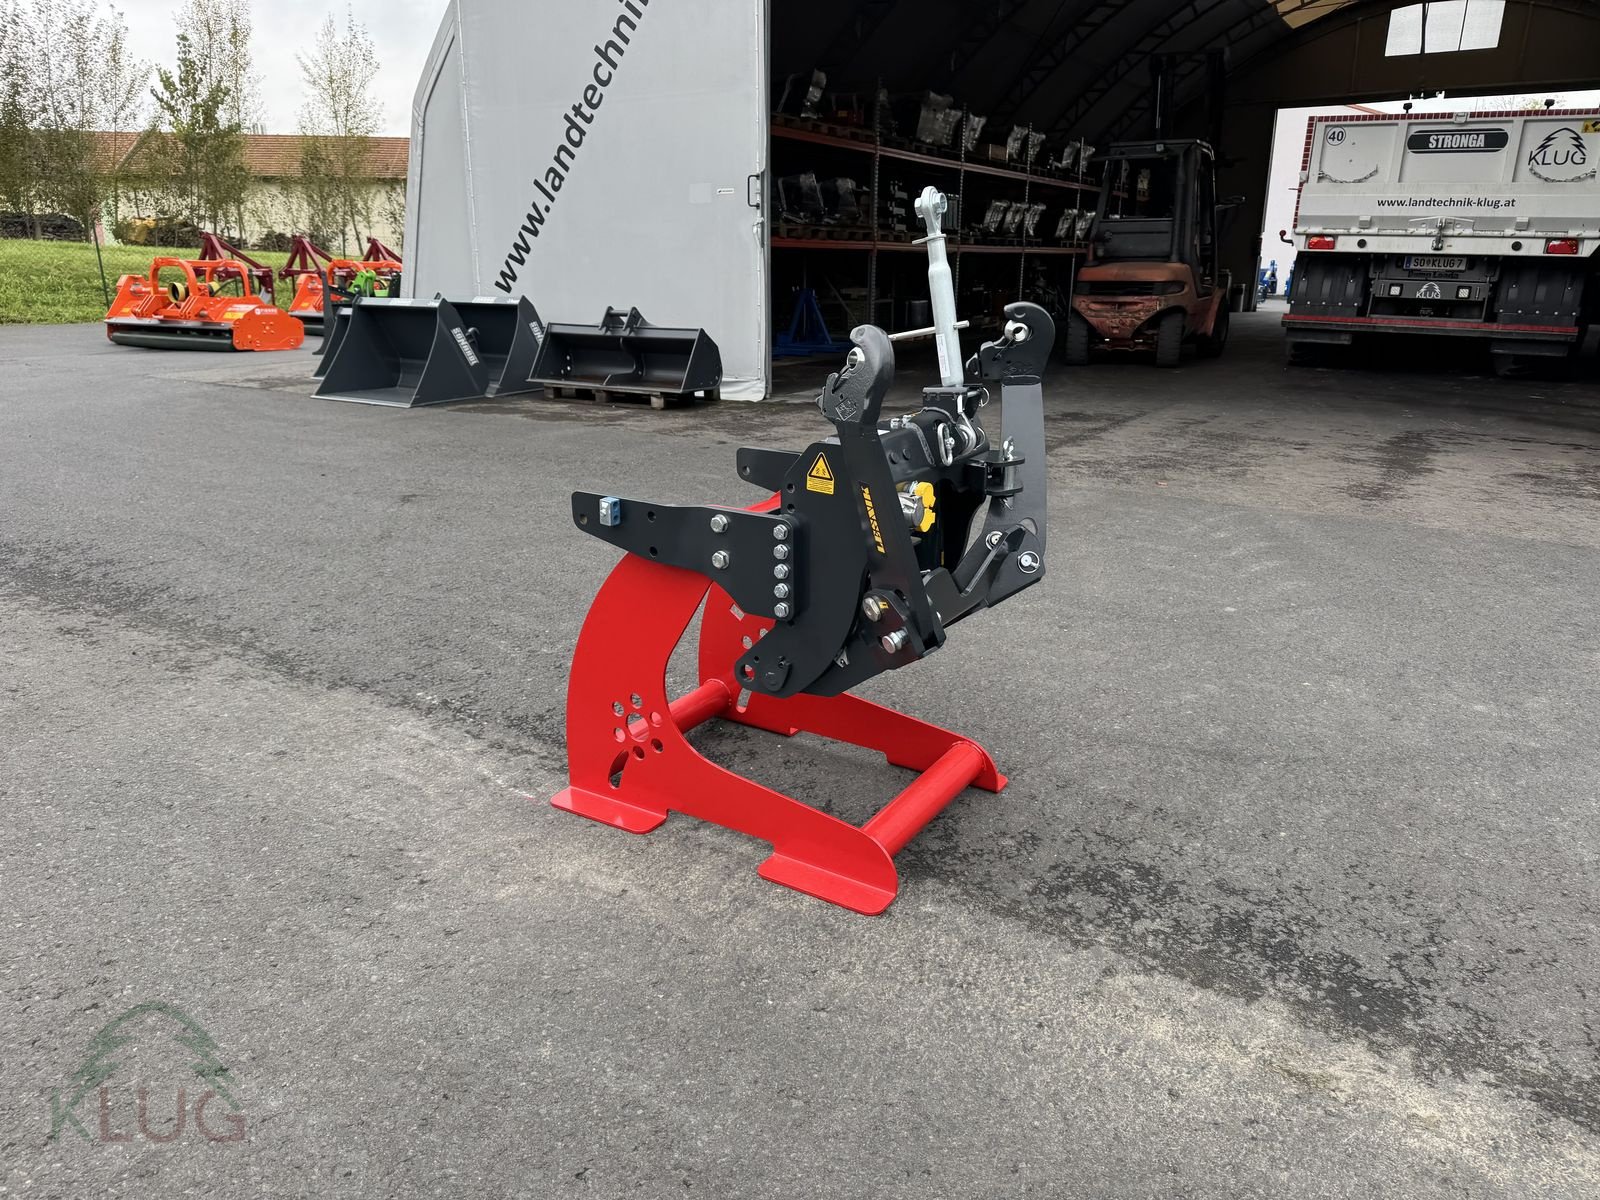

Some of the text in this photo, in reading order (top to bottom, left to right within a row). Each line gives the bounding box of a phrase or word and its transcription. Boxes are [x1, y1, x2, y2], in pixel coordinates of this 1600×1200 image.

[1328, 130, 1344, 141] 40
[1428, 134, 1485, 148] STRONGA
[1528, 150, 1587, 165] KLUG
[1377, 196, 1516, 209] www.landtechnik-klug.at
